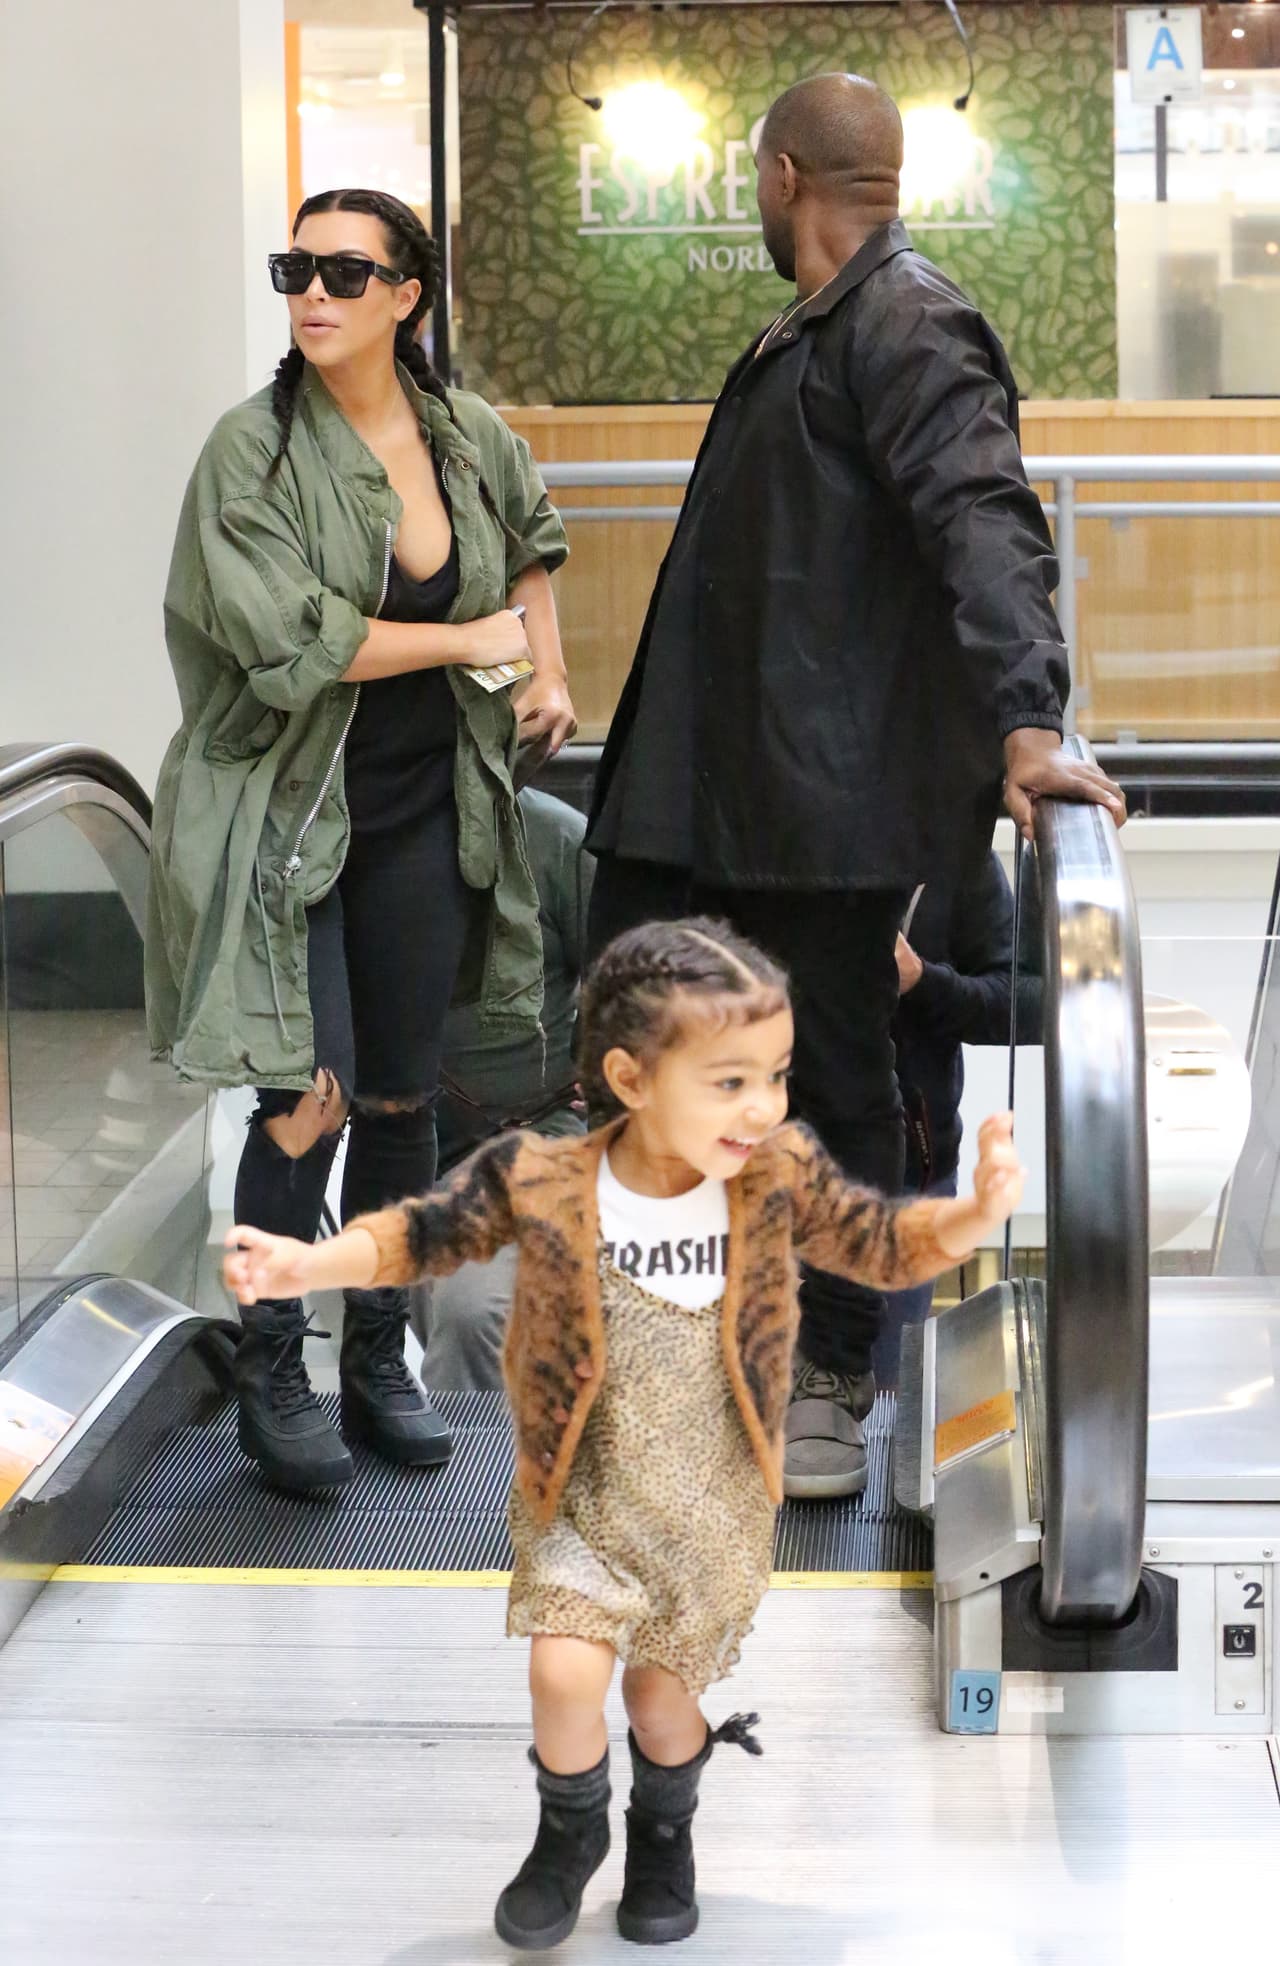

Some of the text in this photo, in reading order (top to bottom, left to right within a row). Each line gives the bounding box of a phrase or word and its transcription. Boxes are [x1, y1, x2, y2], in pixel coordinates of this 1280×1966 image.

[1146, 26, 1184, 71] A
[576, 140, 750, 222] ESPRE
[688, 245, 776, 272] NORD
[1242, 1581, 1265, 1610] 2
[959, 1686, 994, 1714] 19
